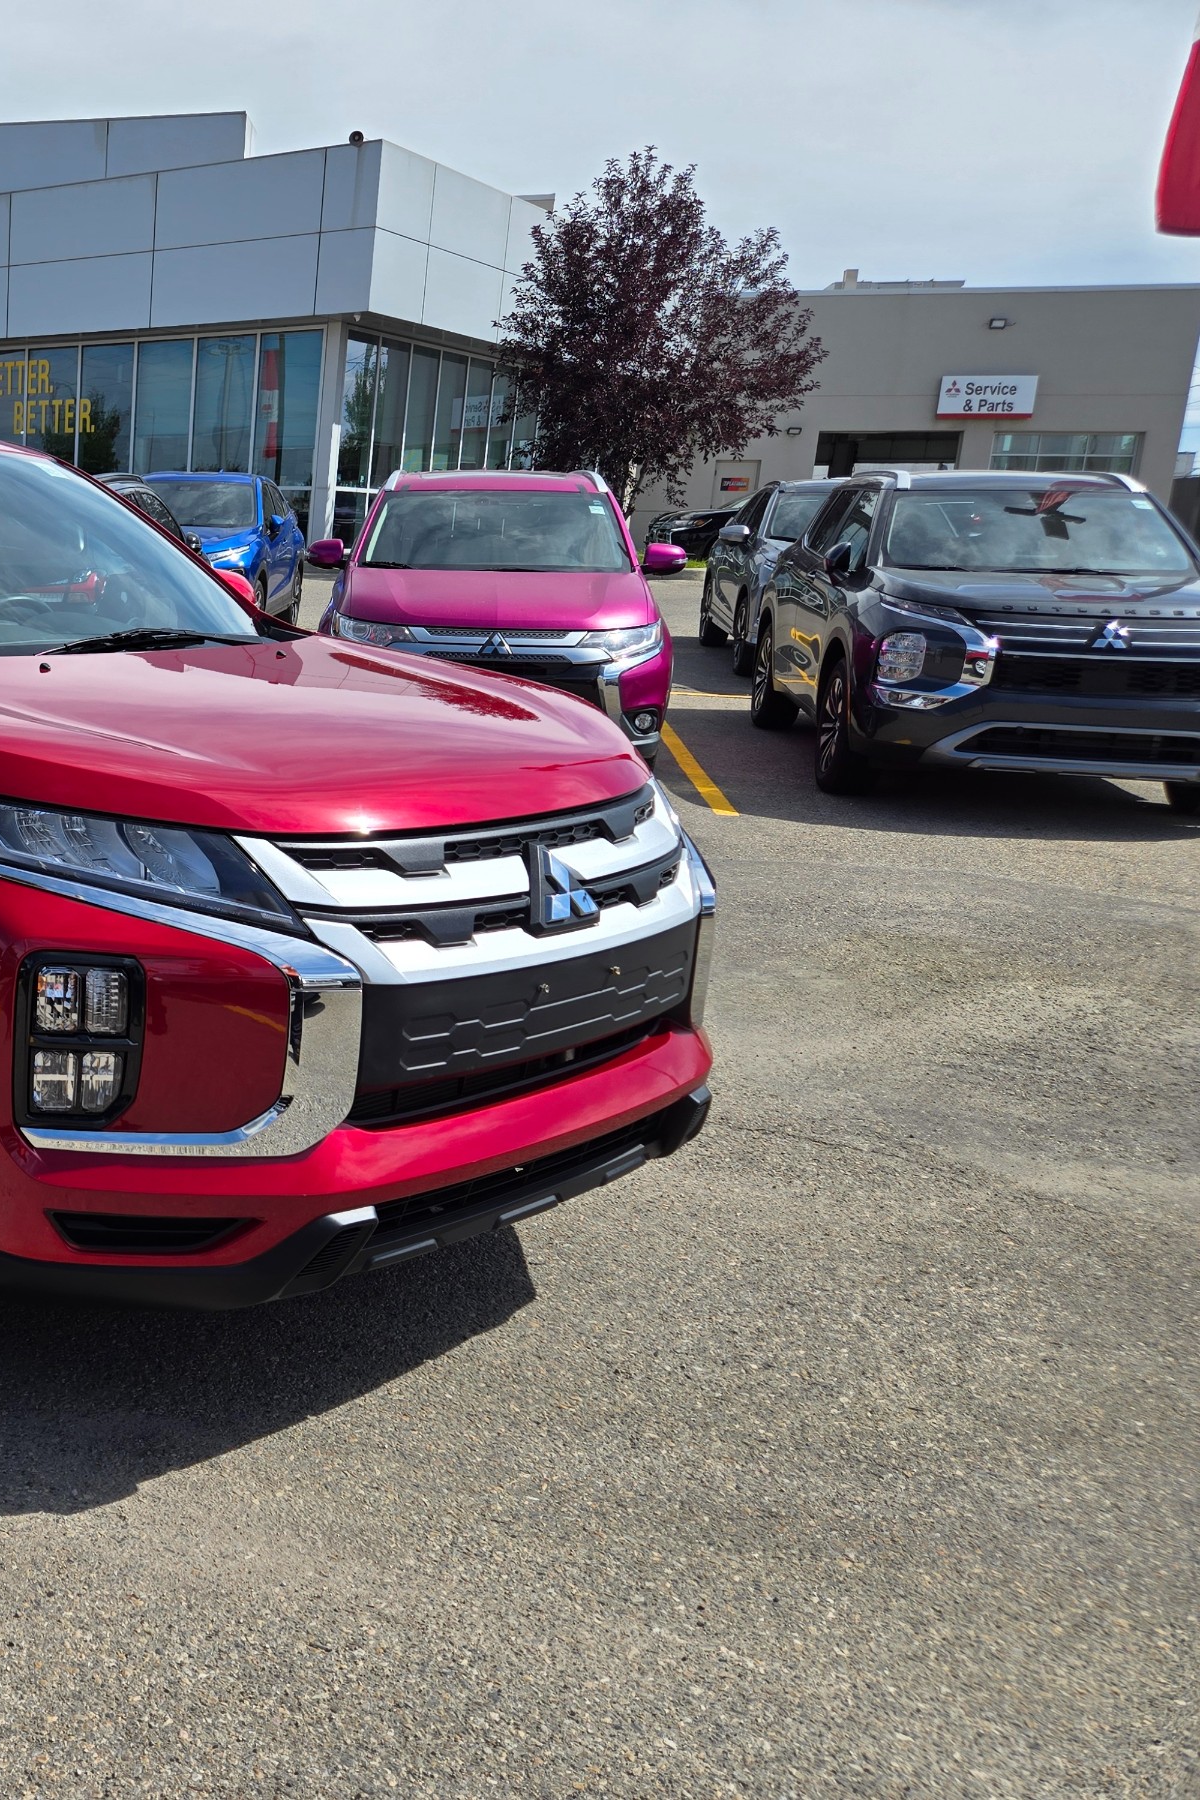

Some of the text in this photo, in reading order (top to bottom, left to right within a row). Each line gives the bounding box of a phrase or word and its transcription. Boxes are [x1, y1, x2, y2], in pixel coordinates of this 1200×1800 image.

[964, 382, 1017, 396] Service
[962, 398, 1014, 412] & Parts
[13, 398, 95, 436] BETTER.
